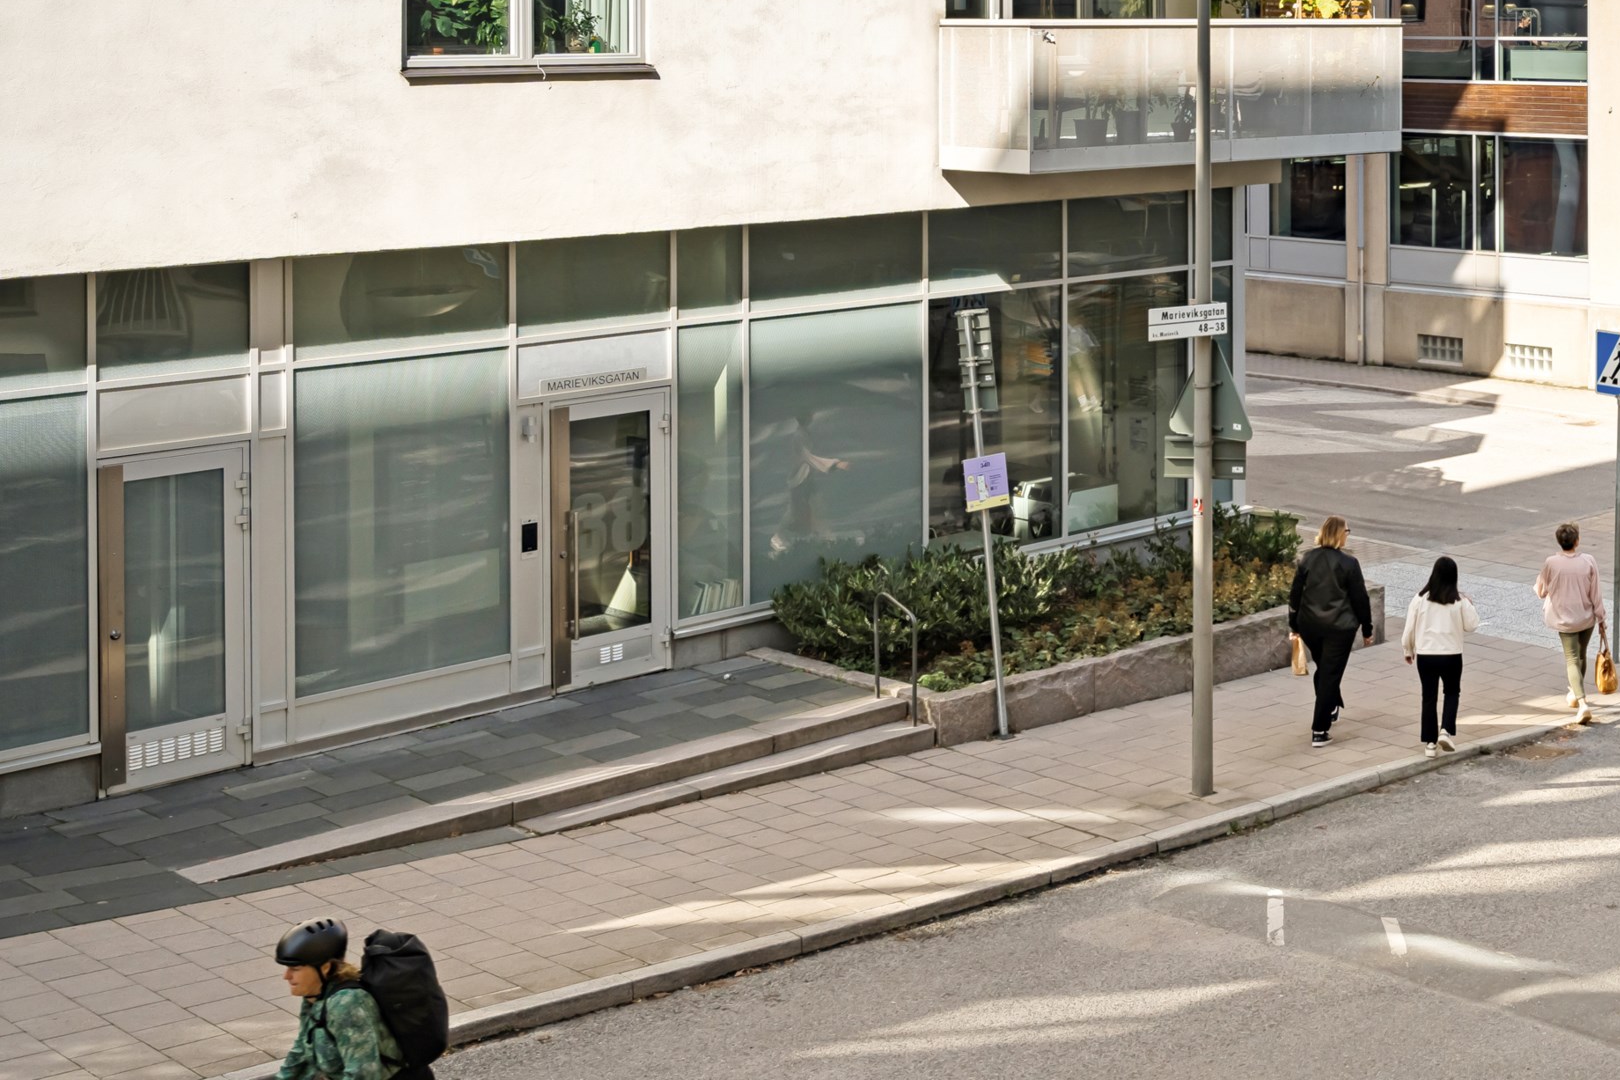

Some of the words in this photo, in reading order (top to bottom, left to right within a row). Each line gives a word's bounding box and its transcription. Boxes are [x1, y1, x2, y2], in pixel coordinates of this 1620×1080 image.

[1161, 308, 1225, 320] Marieviksgatan
[1198, 322, 1225, 333] 48-38
[547, 371, 640, 392] MARIEVIKSGATAN
